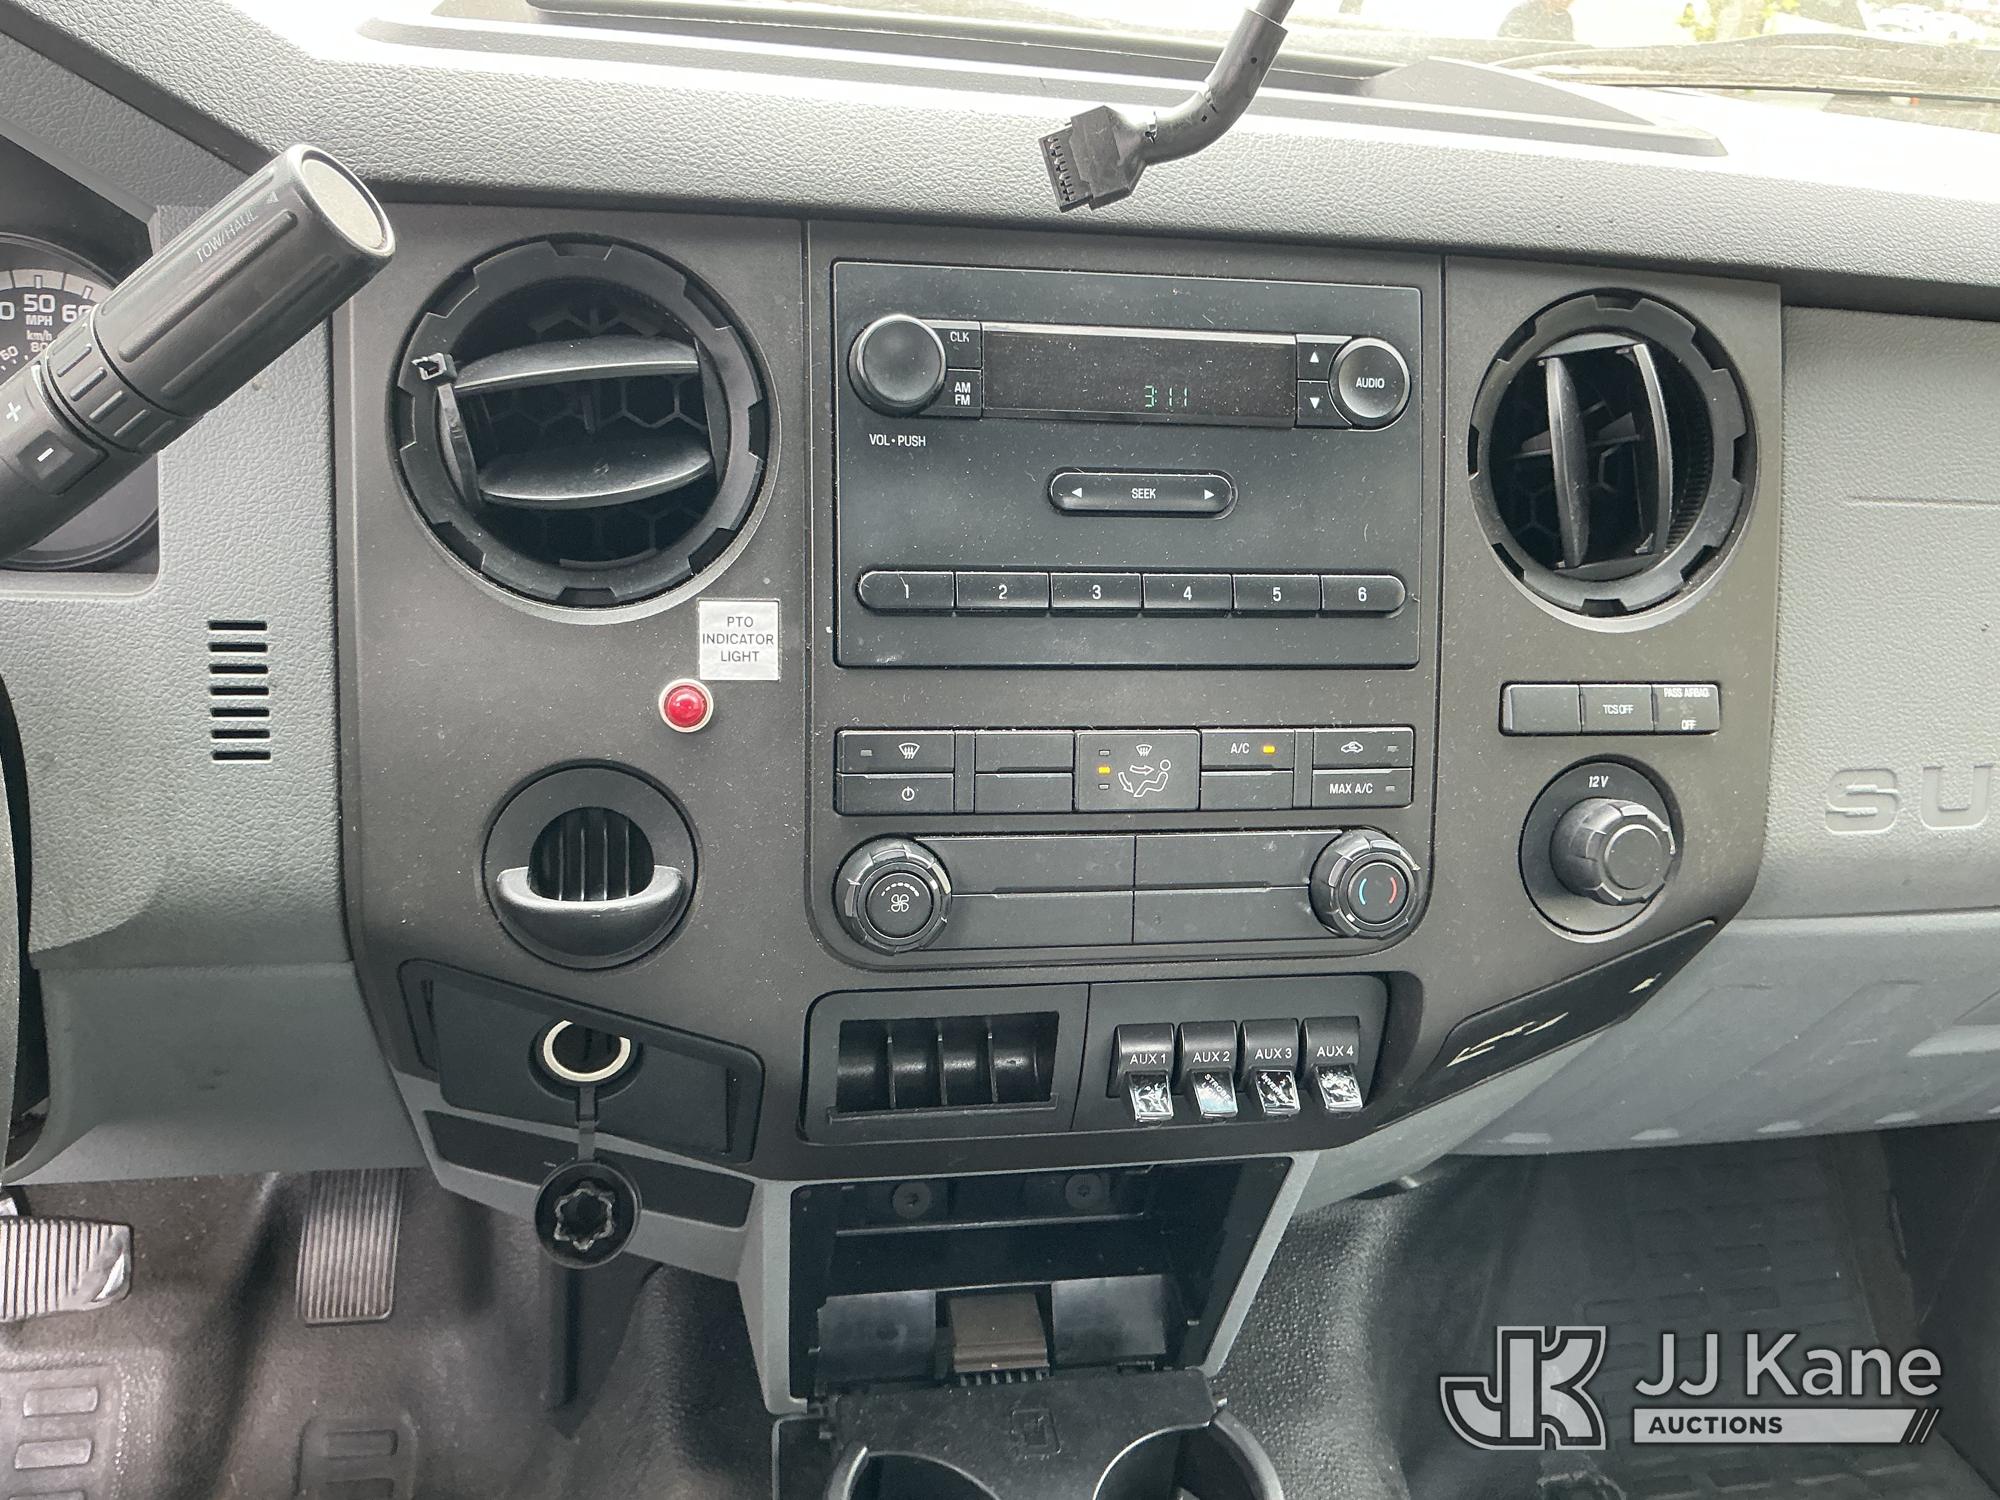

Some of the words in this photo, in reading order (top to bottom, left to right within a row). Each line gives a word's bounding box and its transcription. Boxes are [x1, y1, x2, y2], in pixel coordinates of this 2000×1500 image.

[23, 294, 56, 313] 50
[25, 314, 53, 326] MPH
[949, 330, 970, 343] CLK
[954, 381, 971, 394] AM
[1354, 376, 1385, 390] AUDIO
[954, 394, 971, 406] FM
[1131, 487, 1157, 500] SEEK
[903, 585, 910, 600] 1
[998, 584, 1008, 600] 2
[1092, 585, 1102, 601] 3
[1183, 586, 1193, 601] 4
[1272, 587, 1282, 602] 5
[1357, 587, 1367, 602] 6
[727, 616, 754, 628] PTO
[702, 633, 774, 645] INDICATOR
[720, 651, 760, 662] LIGHT
[1602, 704, 1619, 715] TCS
[1619, 704, 1634, 715] OFF
[1681, 719, 1697, 731] OFF
[1230, 742, 1250, 754] A/C
[1329, 783, 1352, 794] MAX
[1354, 782, 1373, 794] A/C
[1588, 775, 1609, 788] 12V
[1192, 1051, 1220, 1063] AUX
[1222, 1050, 1231, 1062] 2
[1254, 1048, 1283, 1060] AUX
[1284, 1047, 1293, 1059] 3
[1316, 1045, 1344, 1057] AUX
[1346, 1044, 1354, 1056] 4
[1129, 1053, 1157, 1065] AUX
[1160, 1053, 1167, 1064] 1
